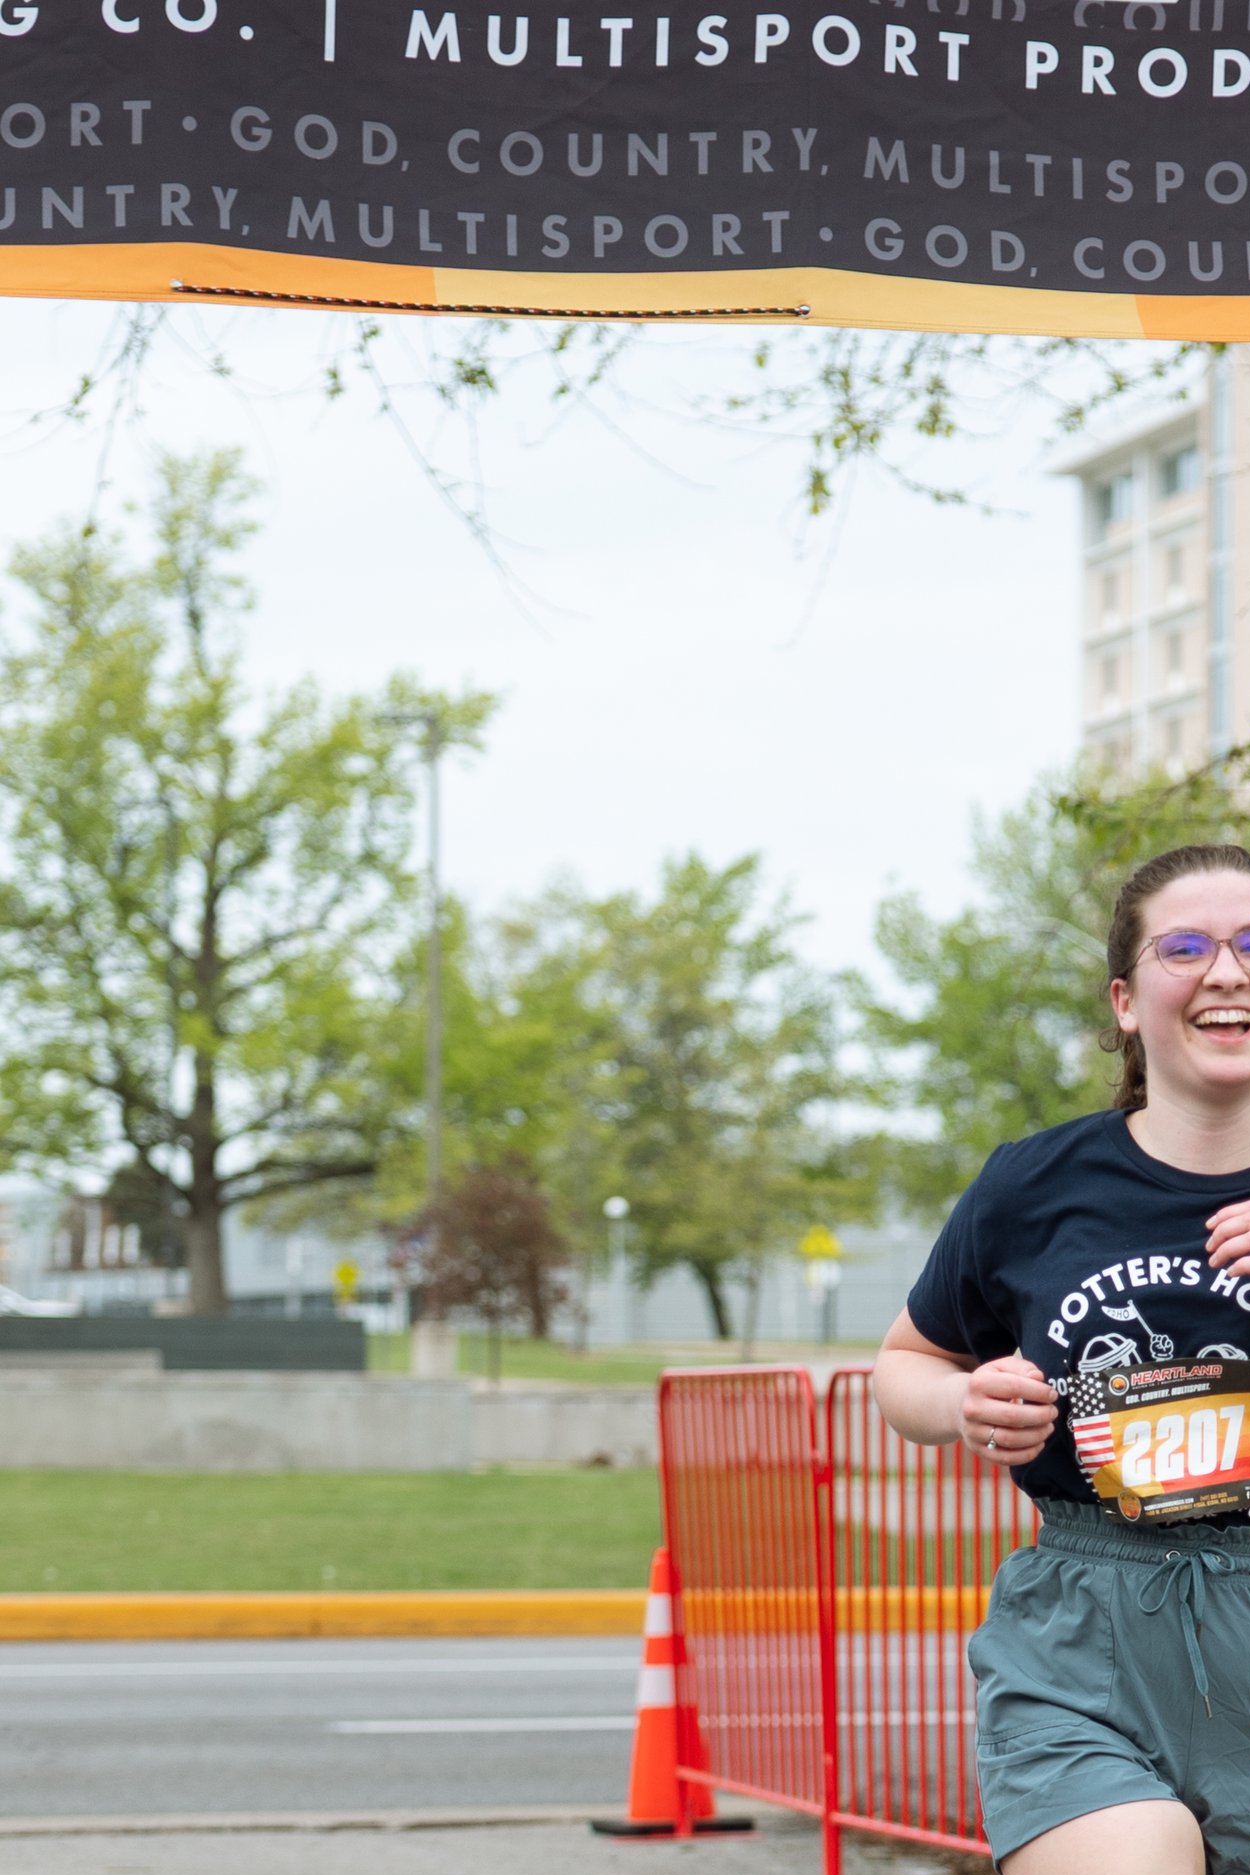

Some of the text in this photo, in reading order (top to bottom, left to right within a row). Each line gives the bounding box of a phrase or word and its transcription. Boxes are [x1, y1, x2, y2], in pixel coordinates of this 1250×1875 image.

[101, 0, 254, 40] CO.
[405, 10, 970, 82] MULTISPORT
[0, 101, 151, 148] ORT
[231, 106, 409, 173] GOD,
[448, 128, 830, 178] COUNTRY,
[287, 197, 790, 258] MULTISPORT
[865, 218, 1037, 278] GOD,
[1047, 1255, 1201, 1348] POTTER'S
[1131, 1364, 1223, 1387] HEARTLAND
[1122, 1405, 1245, 1488] 2207
